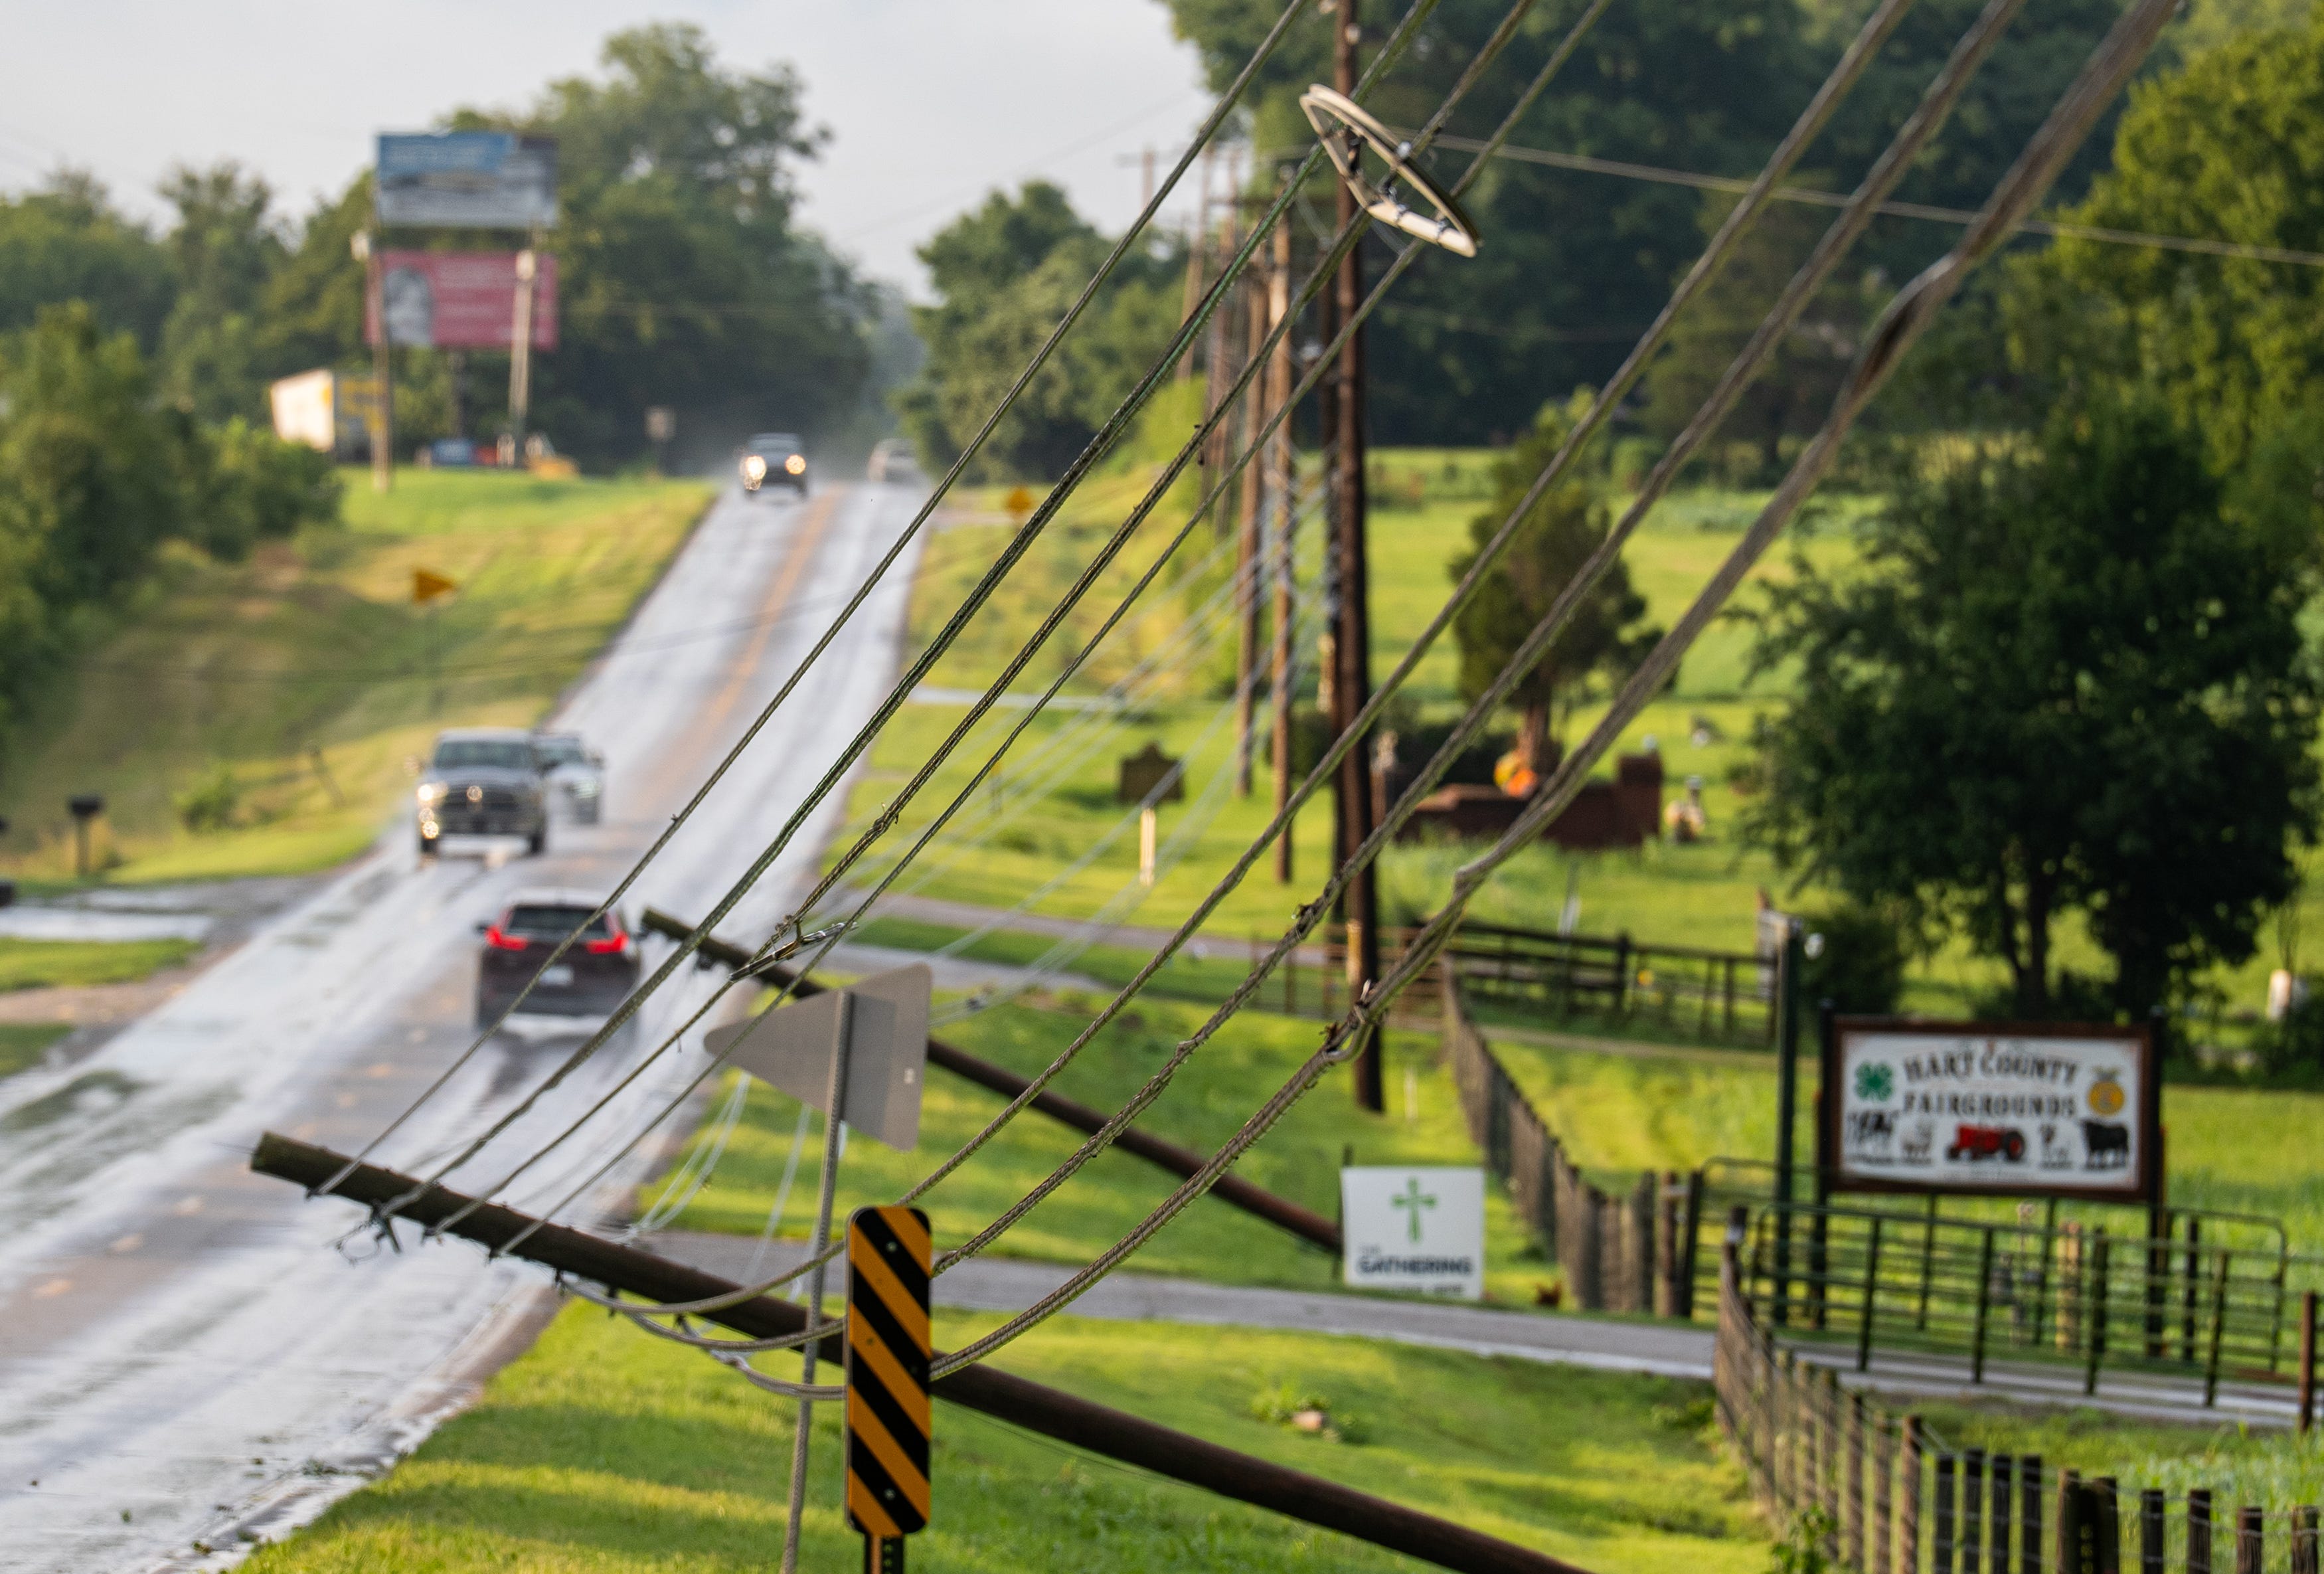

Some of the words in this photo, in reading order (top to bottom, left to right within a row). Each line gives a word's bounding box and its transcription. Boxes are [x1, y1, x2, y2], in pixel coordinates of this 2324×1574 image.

[1904, 1051, 1973, 1082] HART
[1979, 1054, 2077, 1085] COUNTY
[1903, 1092, 2076, 1118] FAIRGROUNDS
[1360, 1255, 1472, 1274] GATHERING
